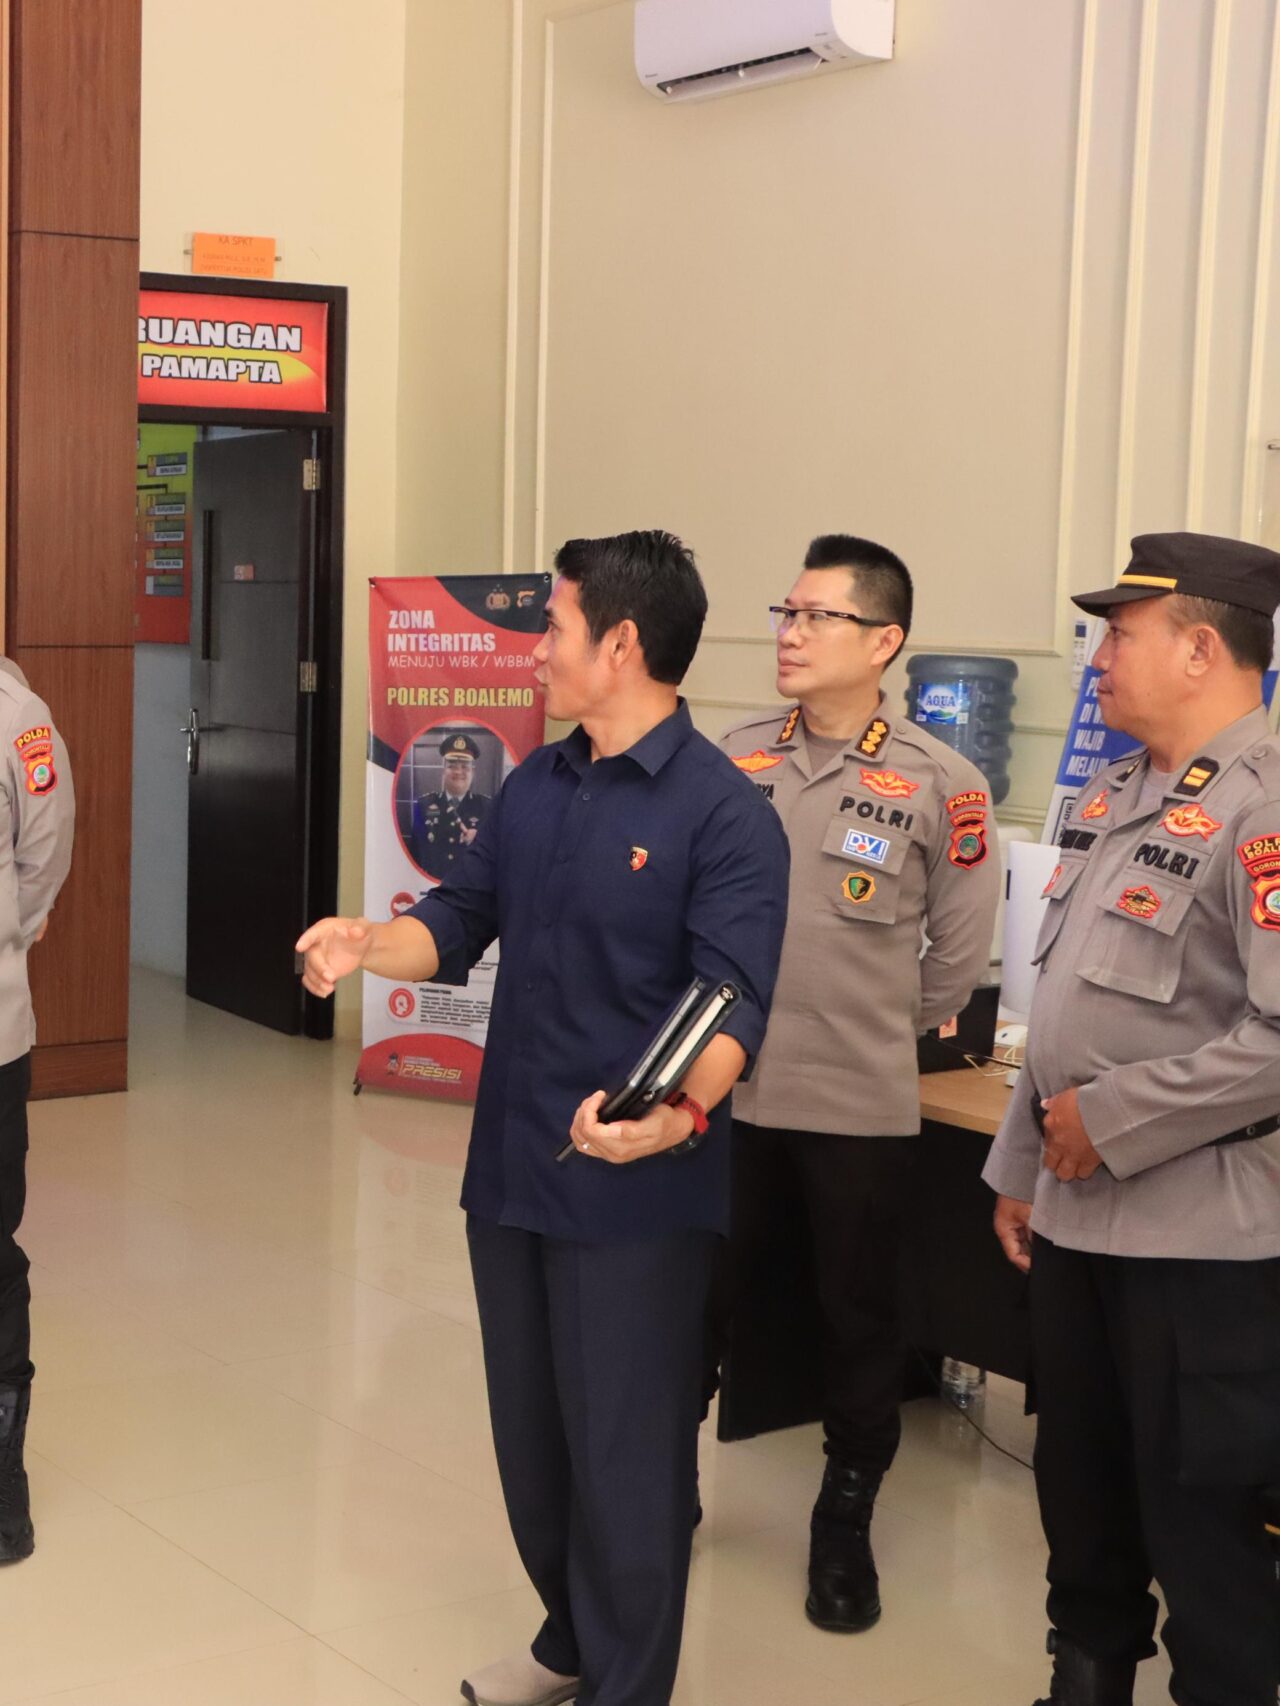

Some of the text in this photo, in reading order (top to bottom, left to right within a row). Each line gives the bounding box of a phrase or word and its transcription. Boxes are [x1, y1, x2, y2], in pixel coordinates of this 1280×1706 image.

[141, 354, 283, 384] PAMAPTA
[388, 610, 435, 629] ZONA
[387, 633, 496, 652] INTEGRITAS
[388, 655, 445, 668] MENUJU
[449, 655, 479, 668] WBK
[494, 655, 535, 668] WBBM
[387, 687, 534, 707] POLRES BOALEMO
[926, 695, 956, 708] AQUA
[17, 727, 49, 748] POLDA
[1073, 729, 1106, 751] WAJIB
[949, 793, 984, 809] POLDA
[839, 796, 914, 831] POLRI
[848, 832, 886, 856] DVI
[1247, 846, 1280, 859] BOAL
[1133, 842, 1200, 879] POLRI
[402, 1064, 462, 1080] PRESISI
